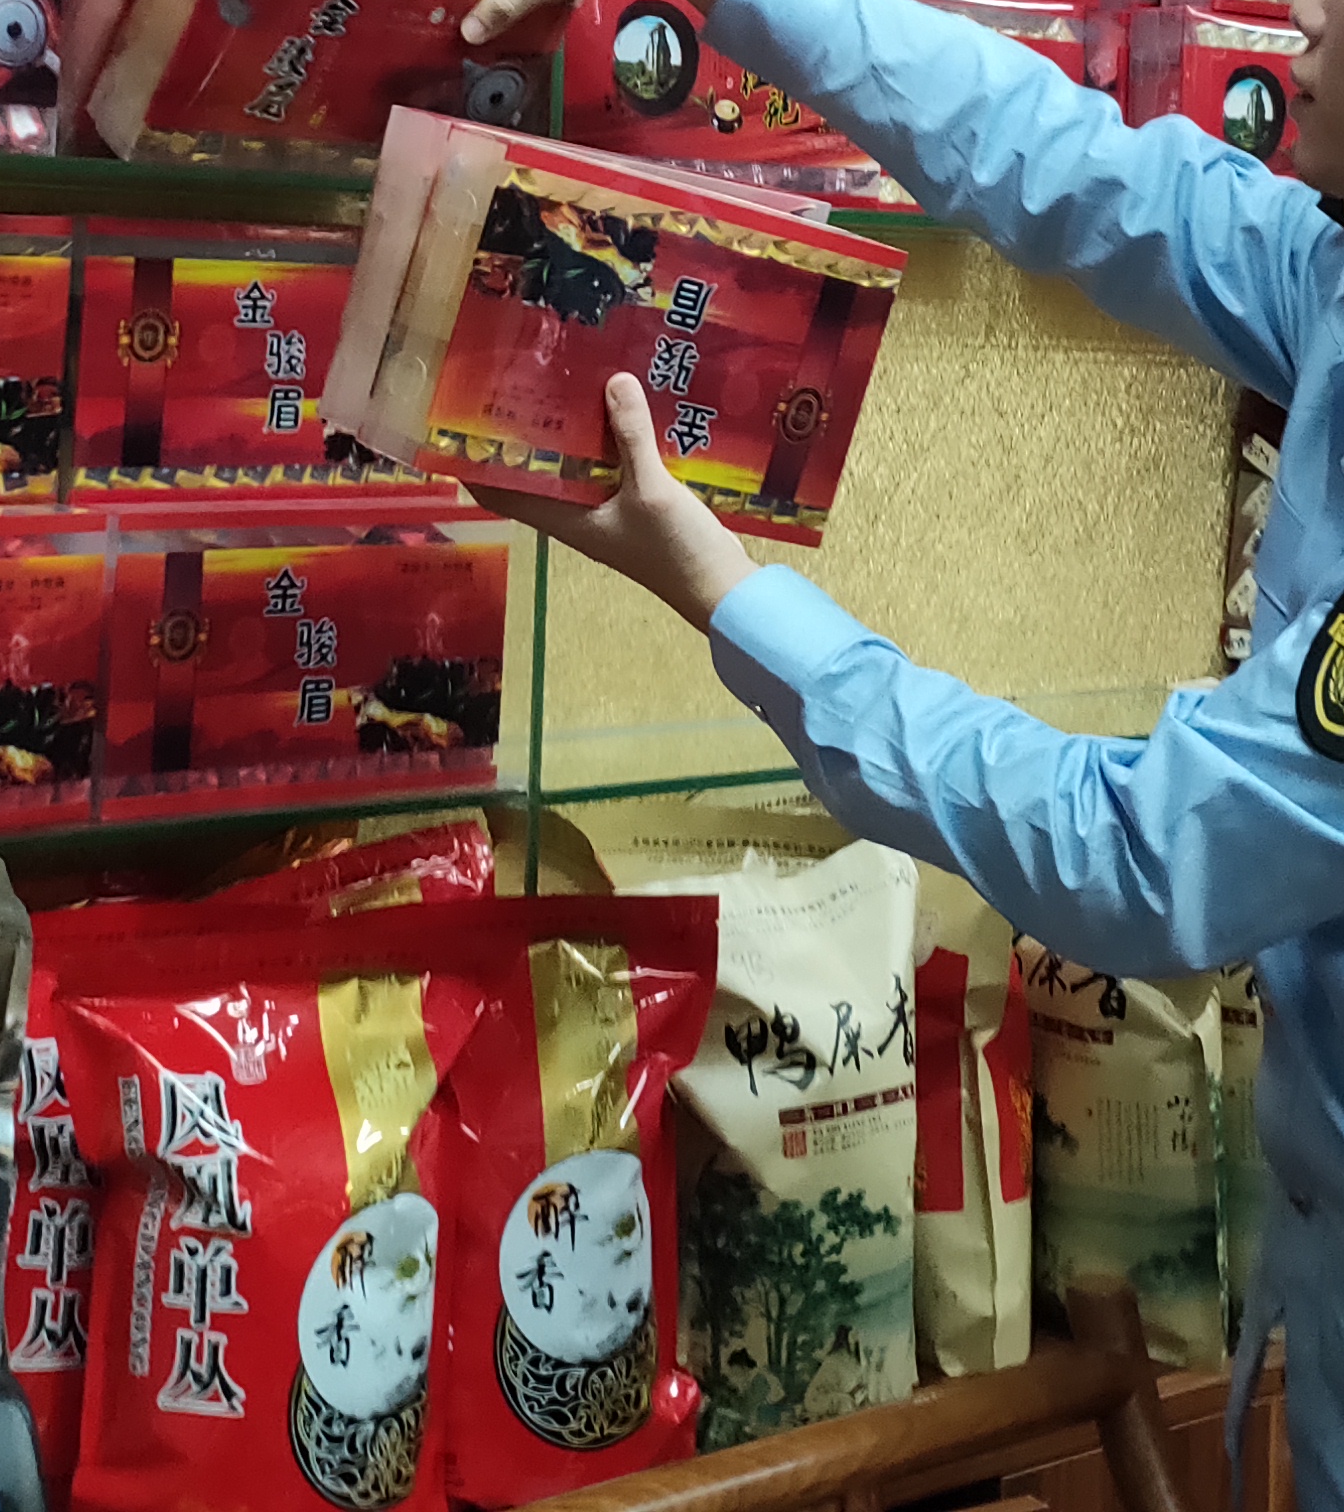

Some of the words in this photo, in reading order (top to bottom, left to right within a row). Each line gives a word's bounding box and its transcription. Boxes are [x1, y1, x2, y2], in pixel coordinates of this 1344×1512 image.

[234, 280, 307, 435] 金骏眉
[647, 274, 720, 459] 金骏眉
[263, 567, 338, 727] 金骏眉
